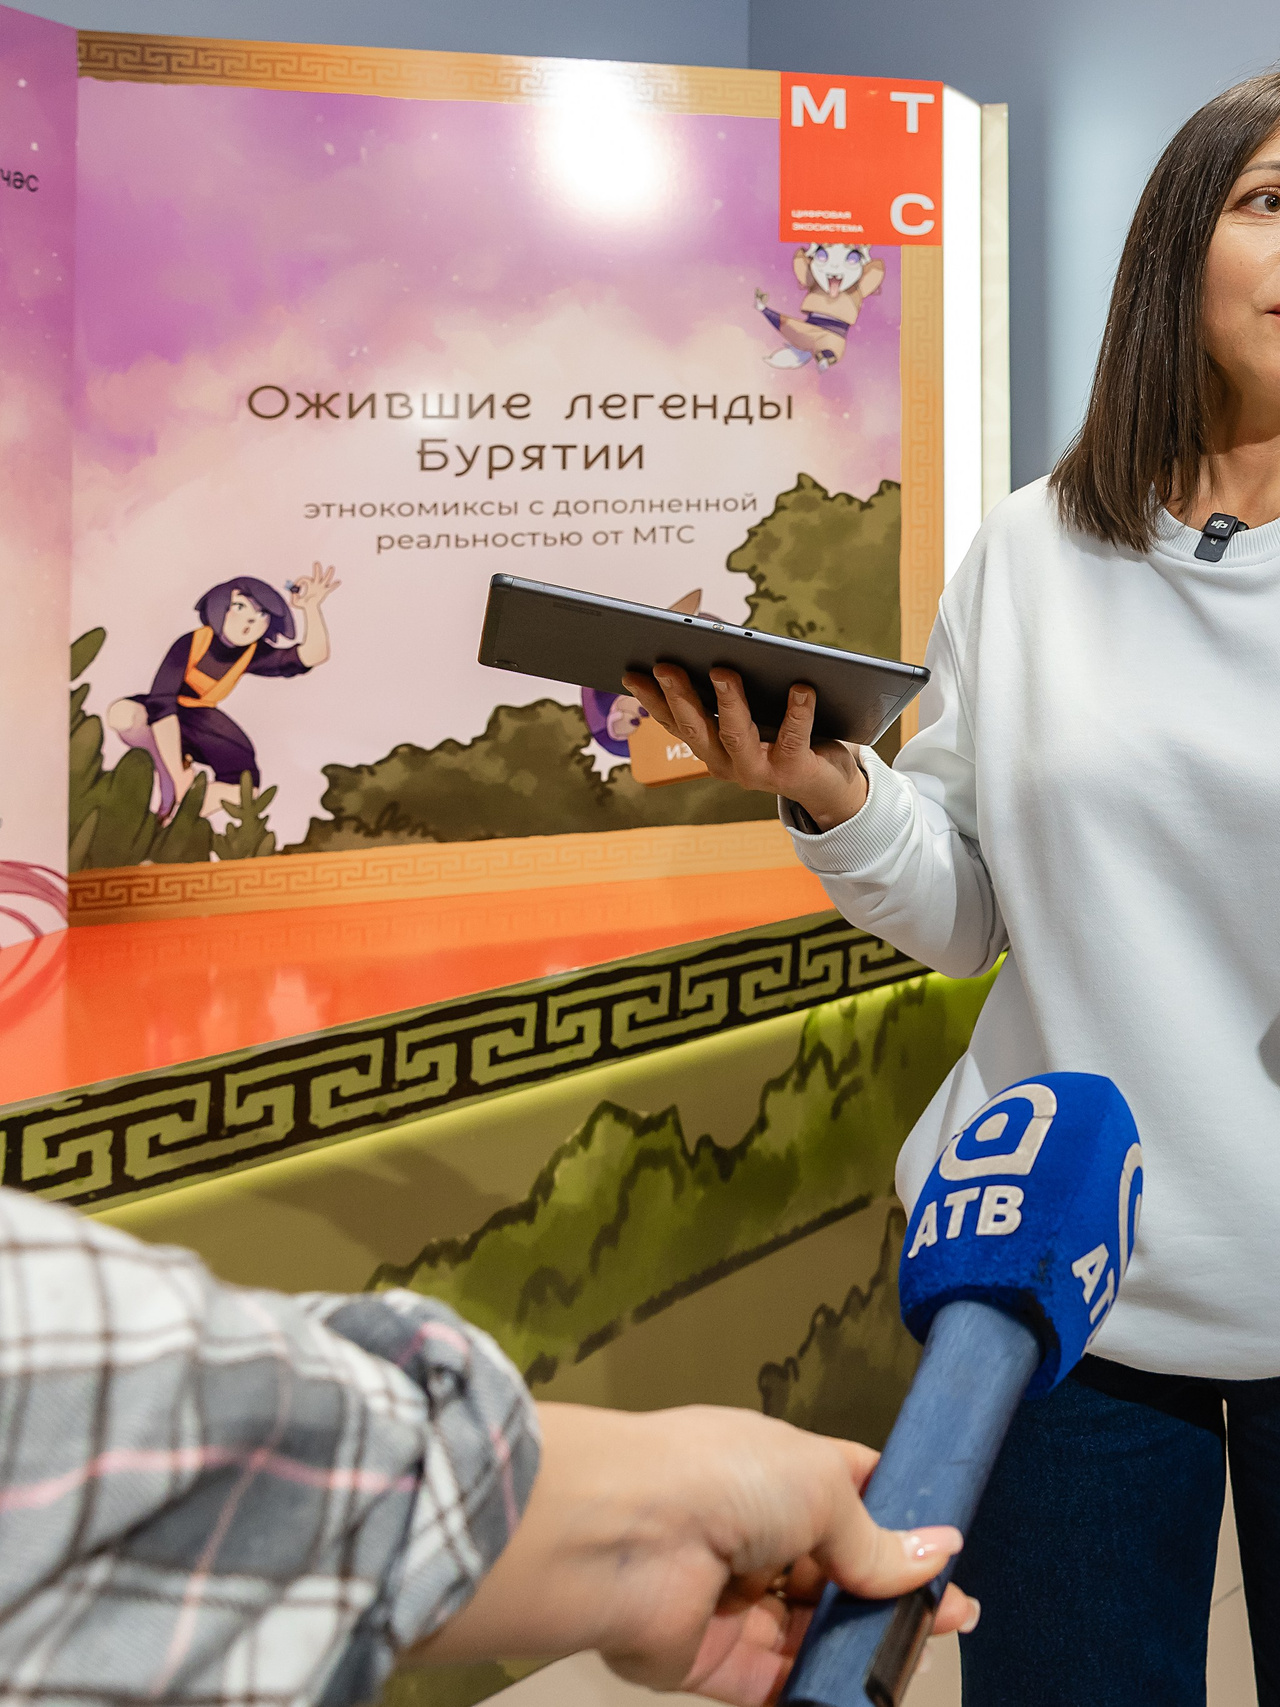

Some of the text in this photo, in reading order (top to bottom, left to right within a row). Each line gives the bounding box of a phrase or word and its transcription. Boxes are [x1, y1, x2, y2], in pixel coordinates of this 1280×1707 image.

[792, 222, 864, 233] ЭКОСИСТЕМА
[248, 385, 793, 425] Ожившие легенды
[417, 438, 645, 480] Бурятии
[303, 493, 758, 520] этнокомиксы с дополненной
[377, 524, 695, 555] реальностью от МТС
[666, 742, 700, 761] ИЗ
[906, 1184, 1026, 1260] АТВ
[1071, 1242, 1116, 1338] АТ
